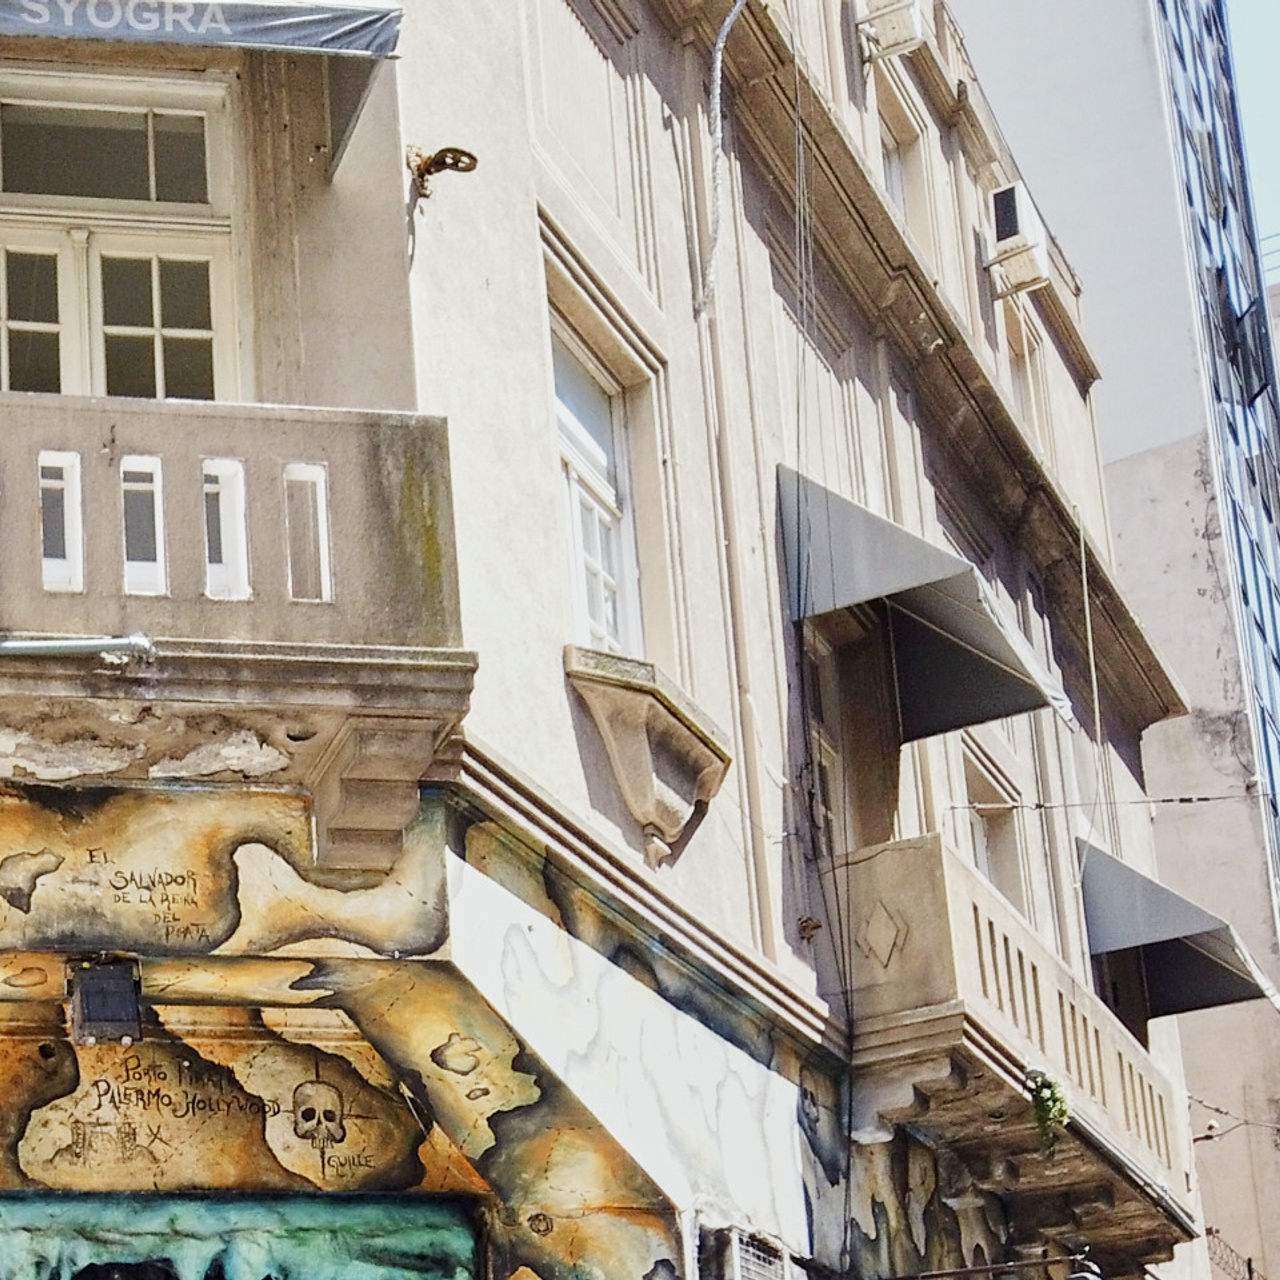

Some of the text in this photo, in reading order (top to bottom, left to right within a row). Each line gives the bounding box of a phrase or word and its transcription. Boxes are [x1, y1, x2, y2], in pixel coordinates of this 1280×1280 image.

[20, 0, 233, 35] SYOGRA
[109, 867, 197, 894] SALVADOR
[114, 892, 131, 904] DE
[123, 1055, 168, 1086] PORTO
[92, 1079, 280, 1118] PALERMO HOLLYWOOD
